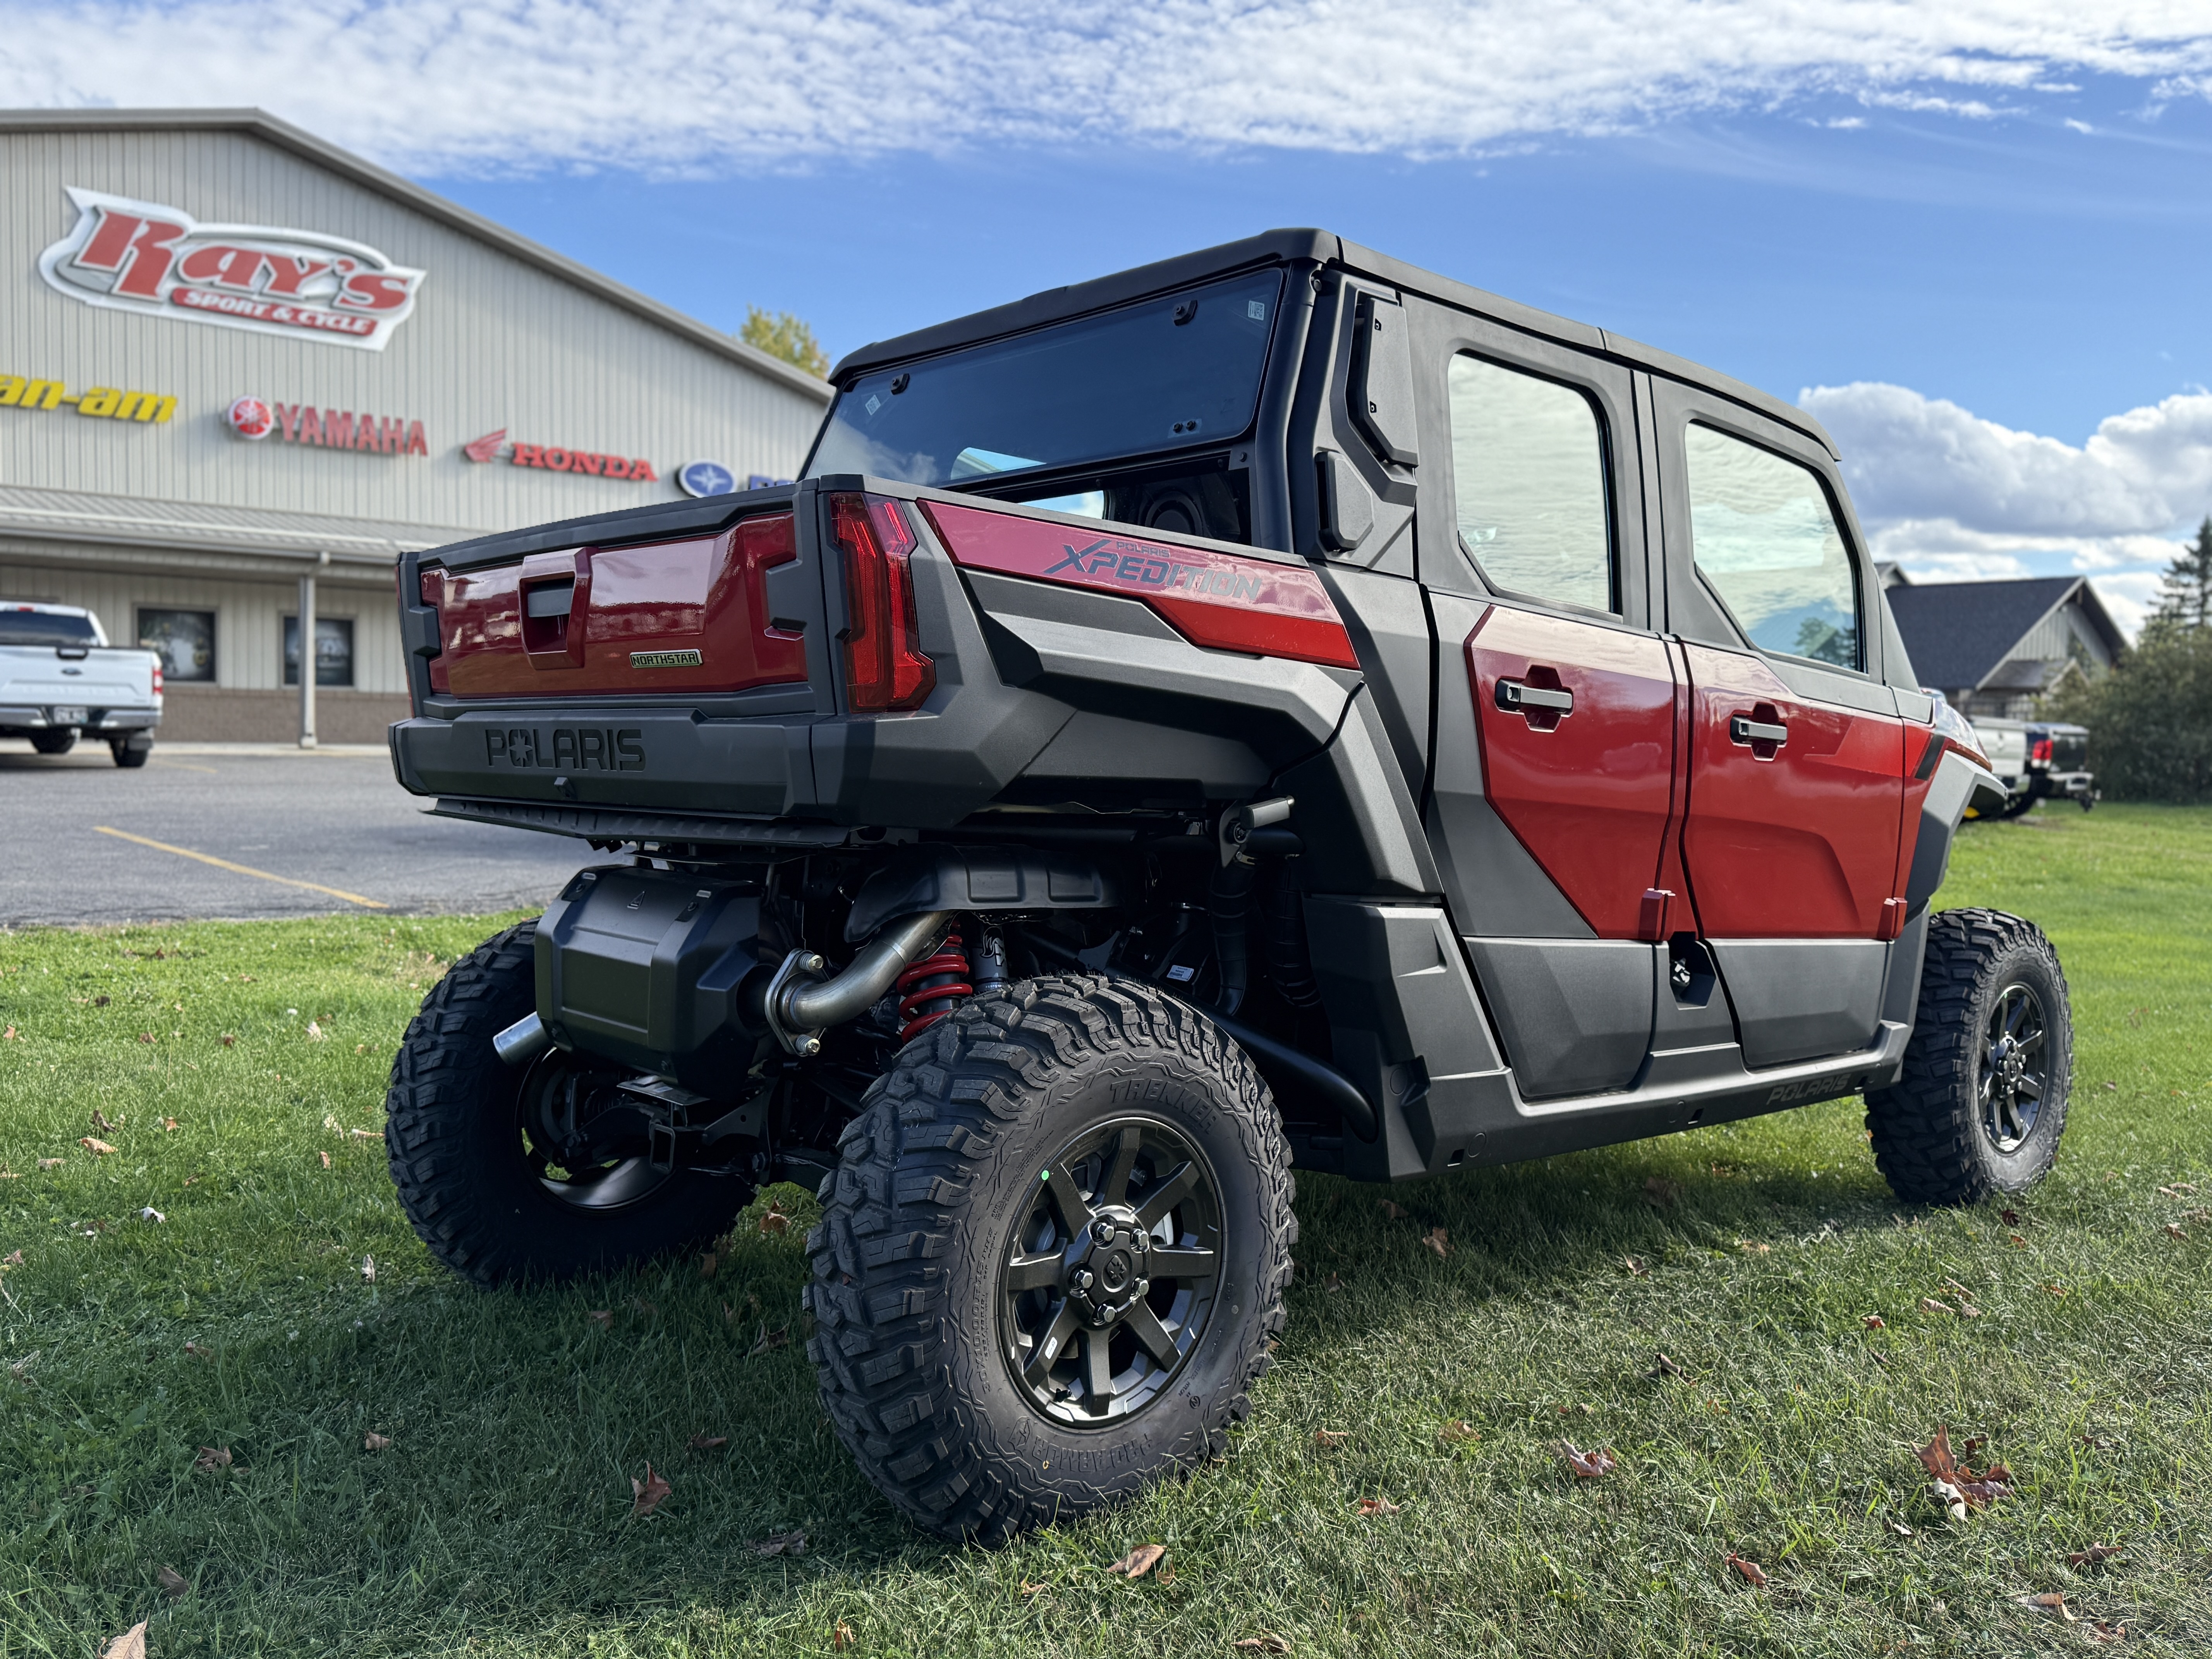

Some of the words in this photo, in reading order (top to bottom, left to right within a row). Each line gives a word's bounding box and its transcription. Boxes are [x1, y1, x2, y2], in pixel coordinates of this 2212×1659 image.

[184, 291, 270, 318] SPORT
[271, 307, 294, 321] &
[297, 308, 370, 334] CYCLE
[276, 402, 428, 456] YAMAHA
[512, 442, 658, 483] HONDA
[1043, 538, 1262, 600] XPEDITION
[1116, 541, 1170, 558] POLARIS
[632, 653, 697, 666] NORTHSTAR
[485, 729, 646, 772] POLARIS
[1109, 1078, 1222, 1135] TREKKER
[1766, 1073, 1852, 1106] POLARIS
